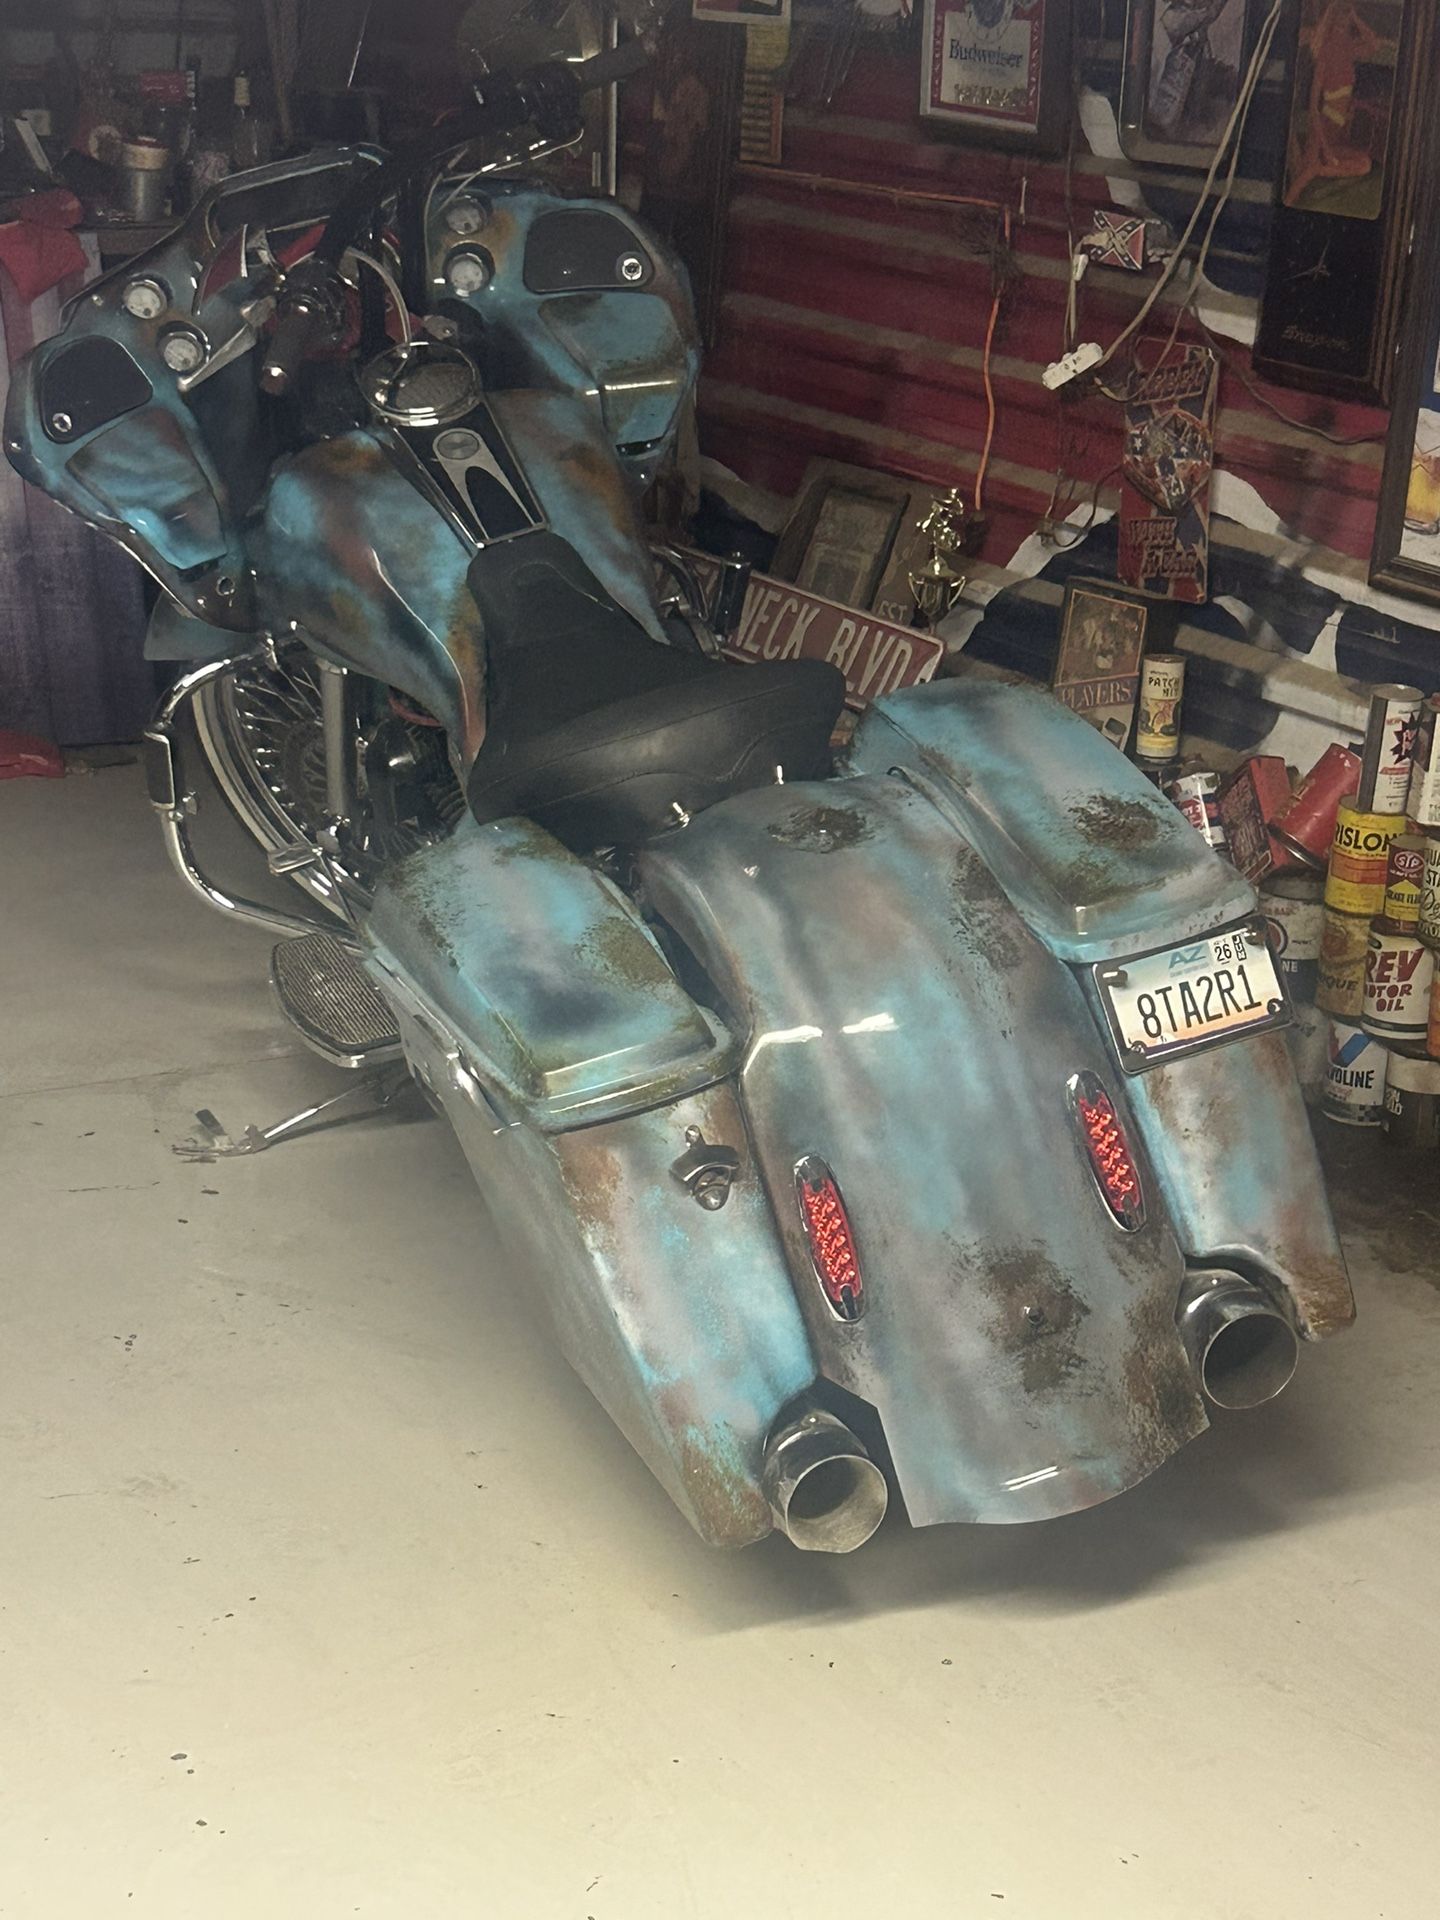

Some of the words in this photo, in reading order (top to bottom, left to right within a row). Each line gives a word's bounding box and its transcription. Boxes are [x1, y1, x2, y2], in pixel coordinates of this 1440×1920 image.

[949, 38, 1023, 68] Budweiser
[825, 617, 913, 697] BLVD
[1061, 680, 1132, 709] PLAYERS
[1398, 851, 1421, 868] STP
[1168, 945, 1206, 969] AZ
[1214, 943, 1232, 963] 26
[1365, 947, 1425, 983] REV
[1136, 964, 1262, 1039] 8TA2R1
[1376, 999, 1404, 1012] OIL
